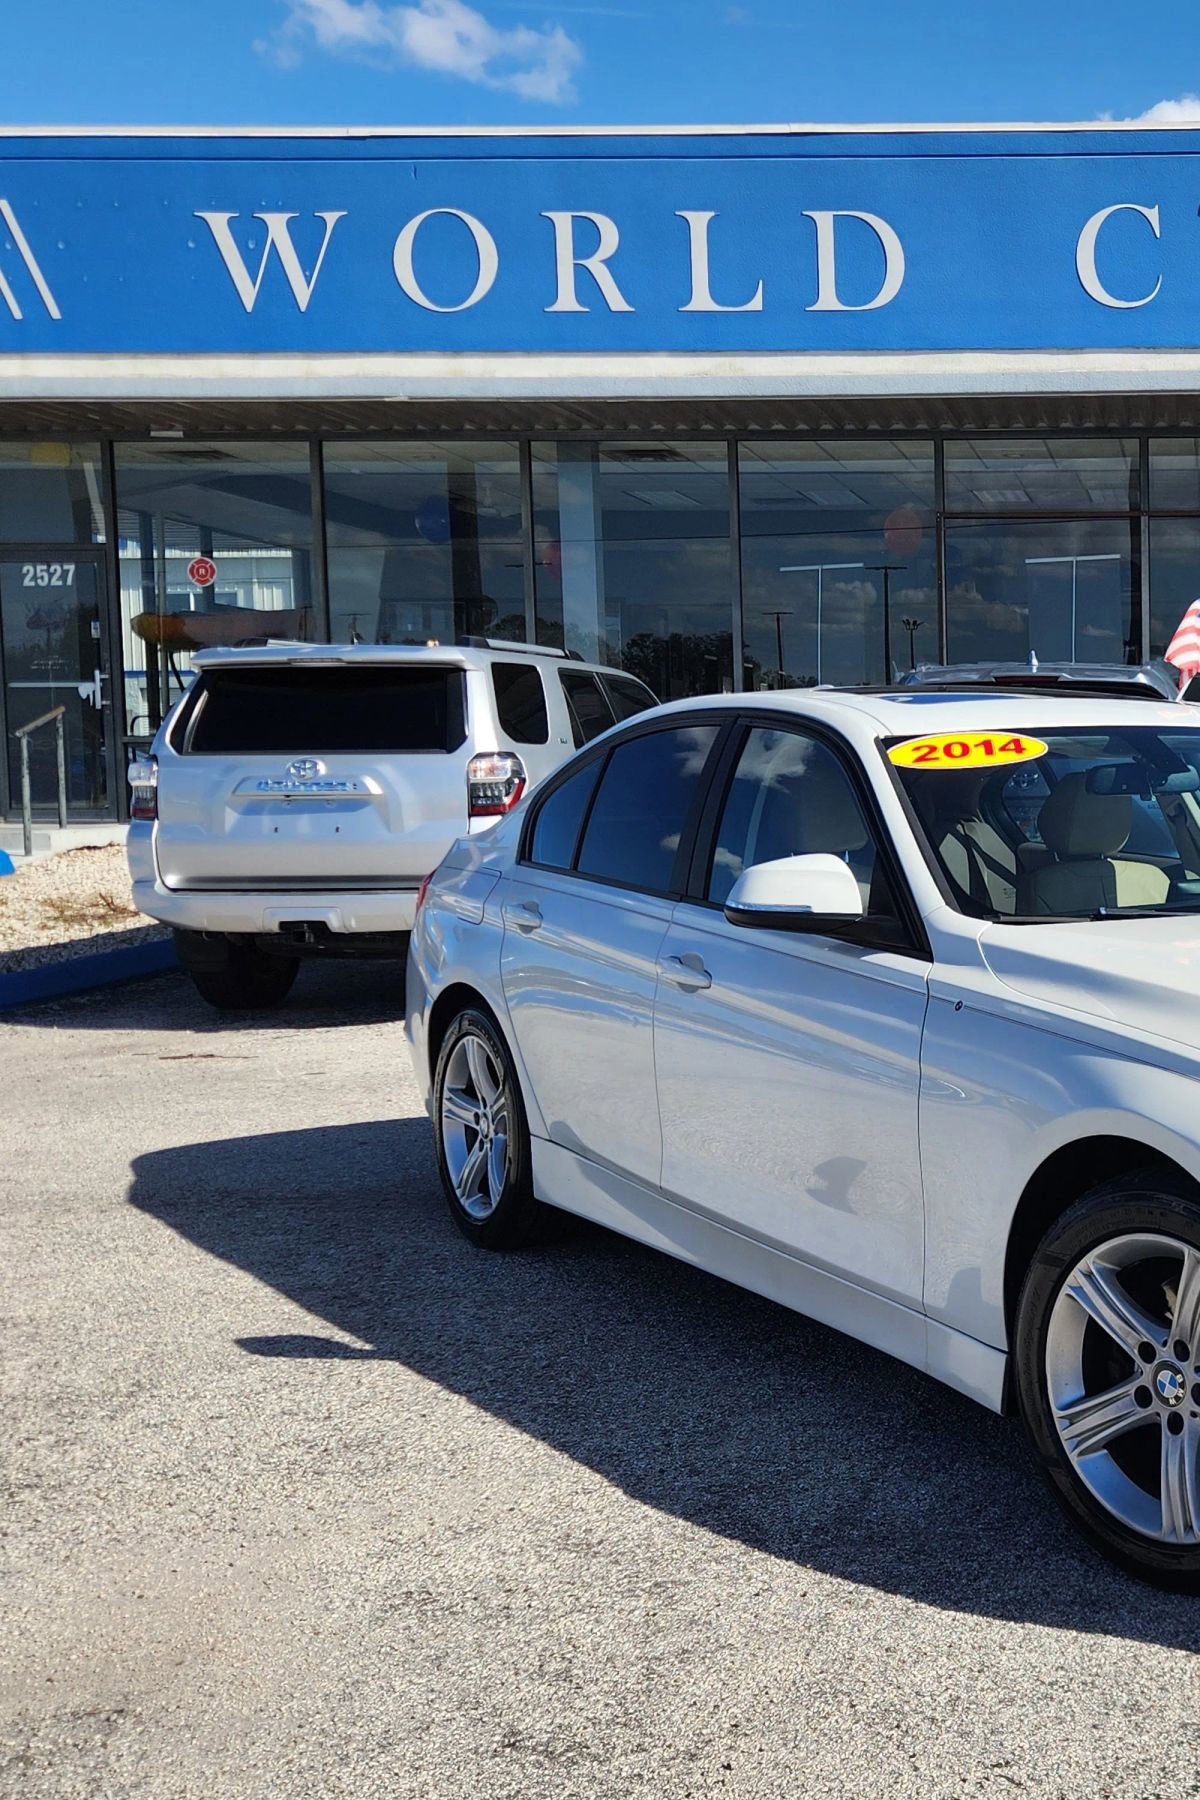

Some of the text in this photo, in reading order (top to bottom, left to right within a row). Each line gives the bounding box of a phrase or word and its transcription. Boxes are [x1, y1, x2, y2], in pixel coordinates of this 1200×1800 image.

[196, 208, 907, 314] WORLD
[22, 564, 76, 587] 2527
[912, 738, 1027, 763] 2014
